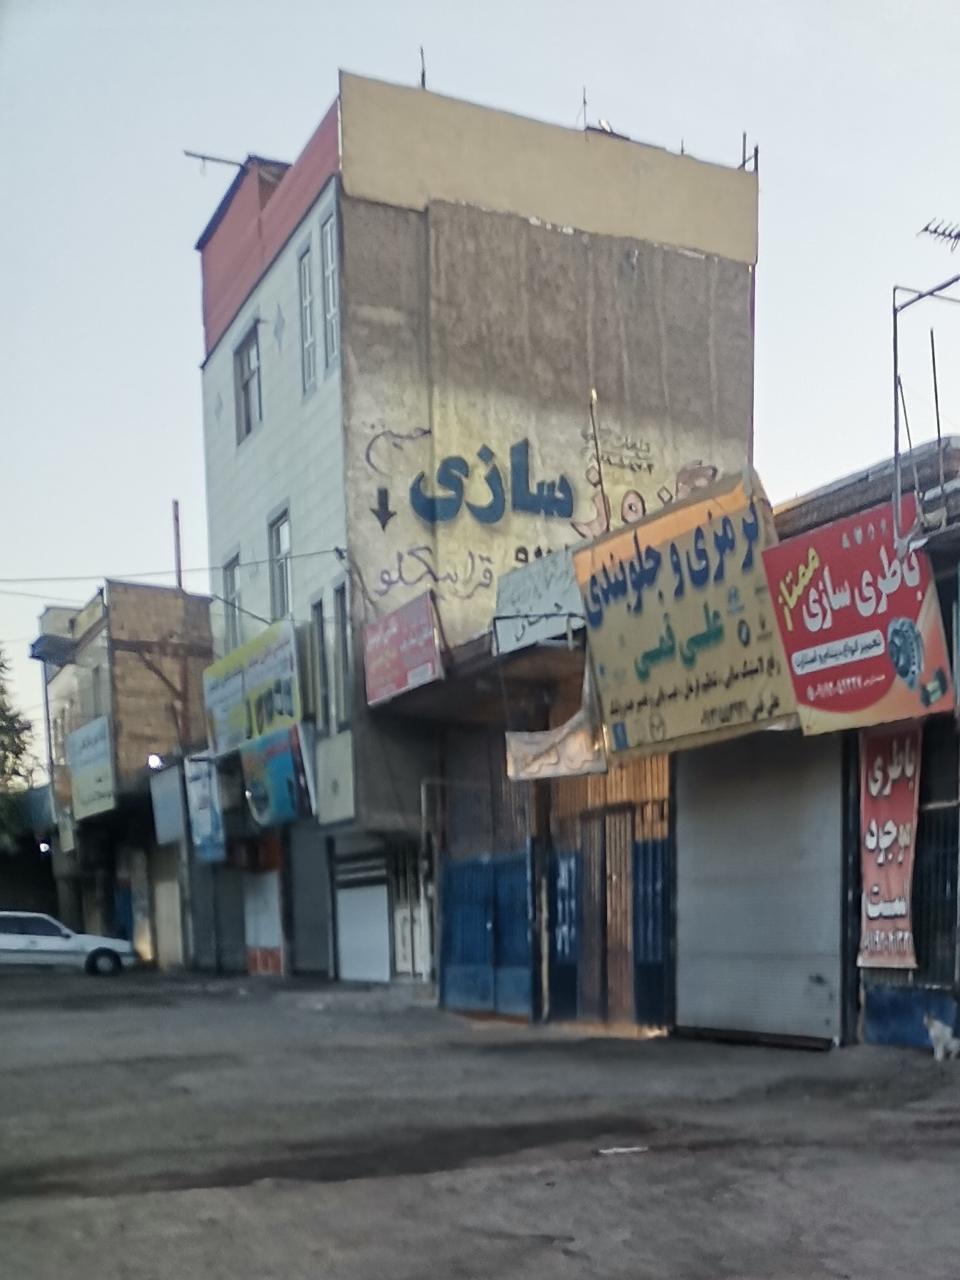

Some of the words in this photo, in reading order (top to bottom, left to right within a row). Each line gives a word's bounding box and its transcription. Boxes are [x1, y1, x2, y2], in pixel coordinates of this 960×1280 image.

[408, 437, 575, 525] سازی
[584, 528, 662, 629] جلوبندی
[669, 541, 685, 599] و
[778, 546, 821, 632] ممتاز
[802, 564, 851, 633] سازی
[854, 544, 923, 618] باطری
[868, 737, 916, 797] باطری
